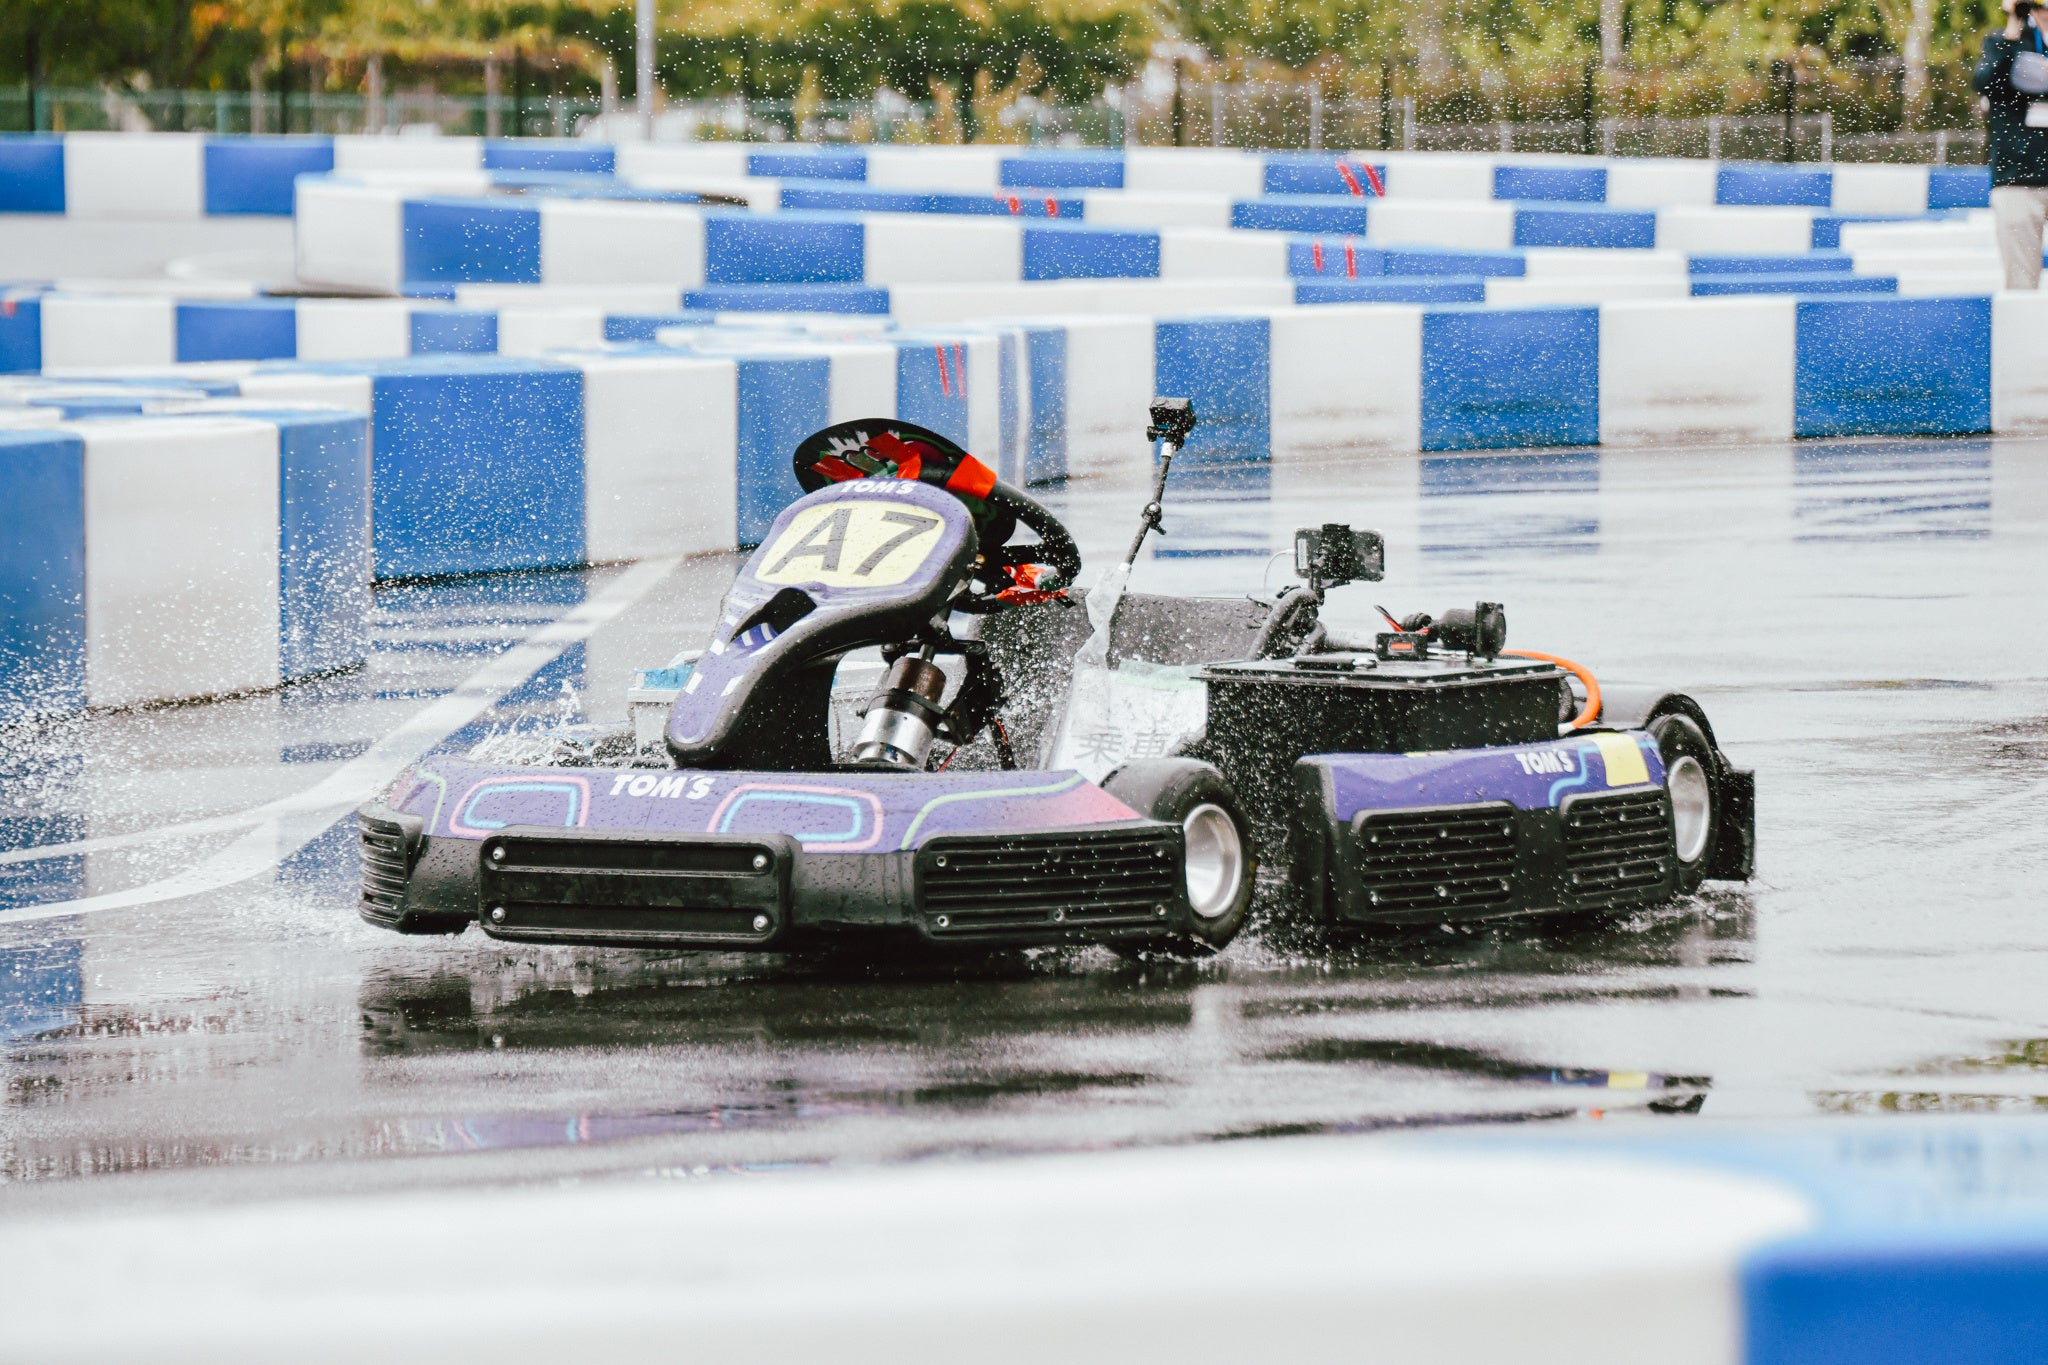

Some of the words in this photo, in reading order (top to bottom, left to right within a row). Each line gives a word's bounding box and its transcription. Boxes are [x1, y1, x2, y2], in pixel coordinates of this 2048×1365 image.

[840, 480, 917, 495] TOM'S
[764, 508, 939, 577] A7
[1515, 749, 1575, 776] TOM'S
[609, 774, 716, 800] TOM'S
